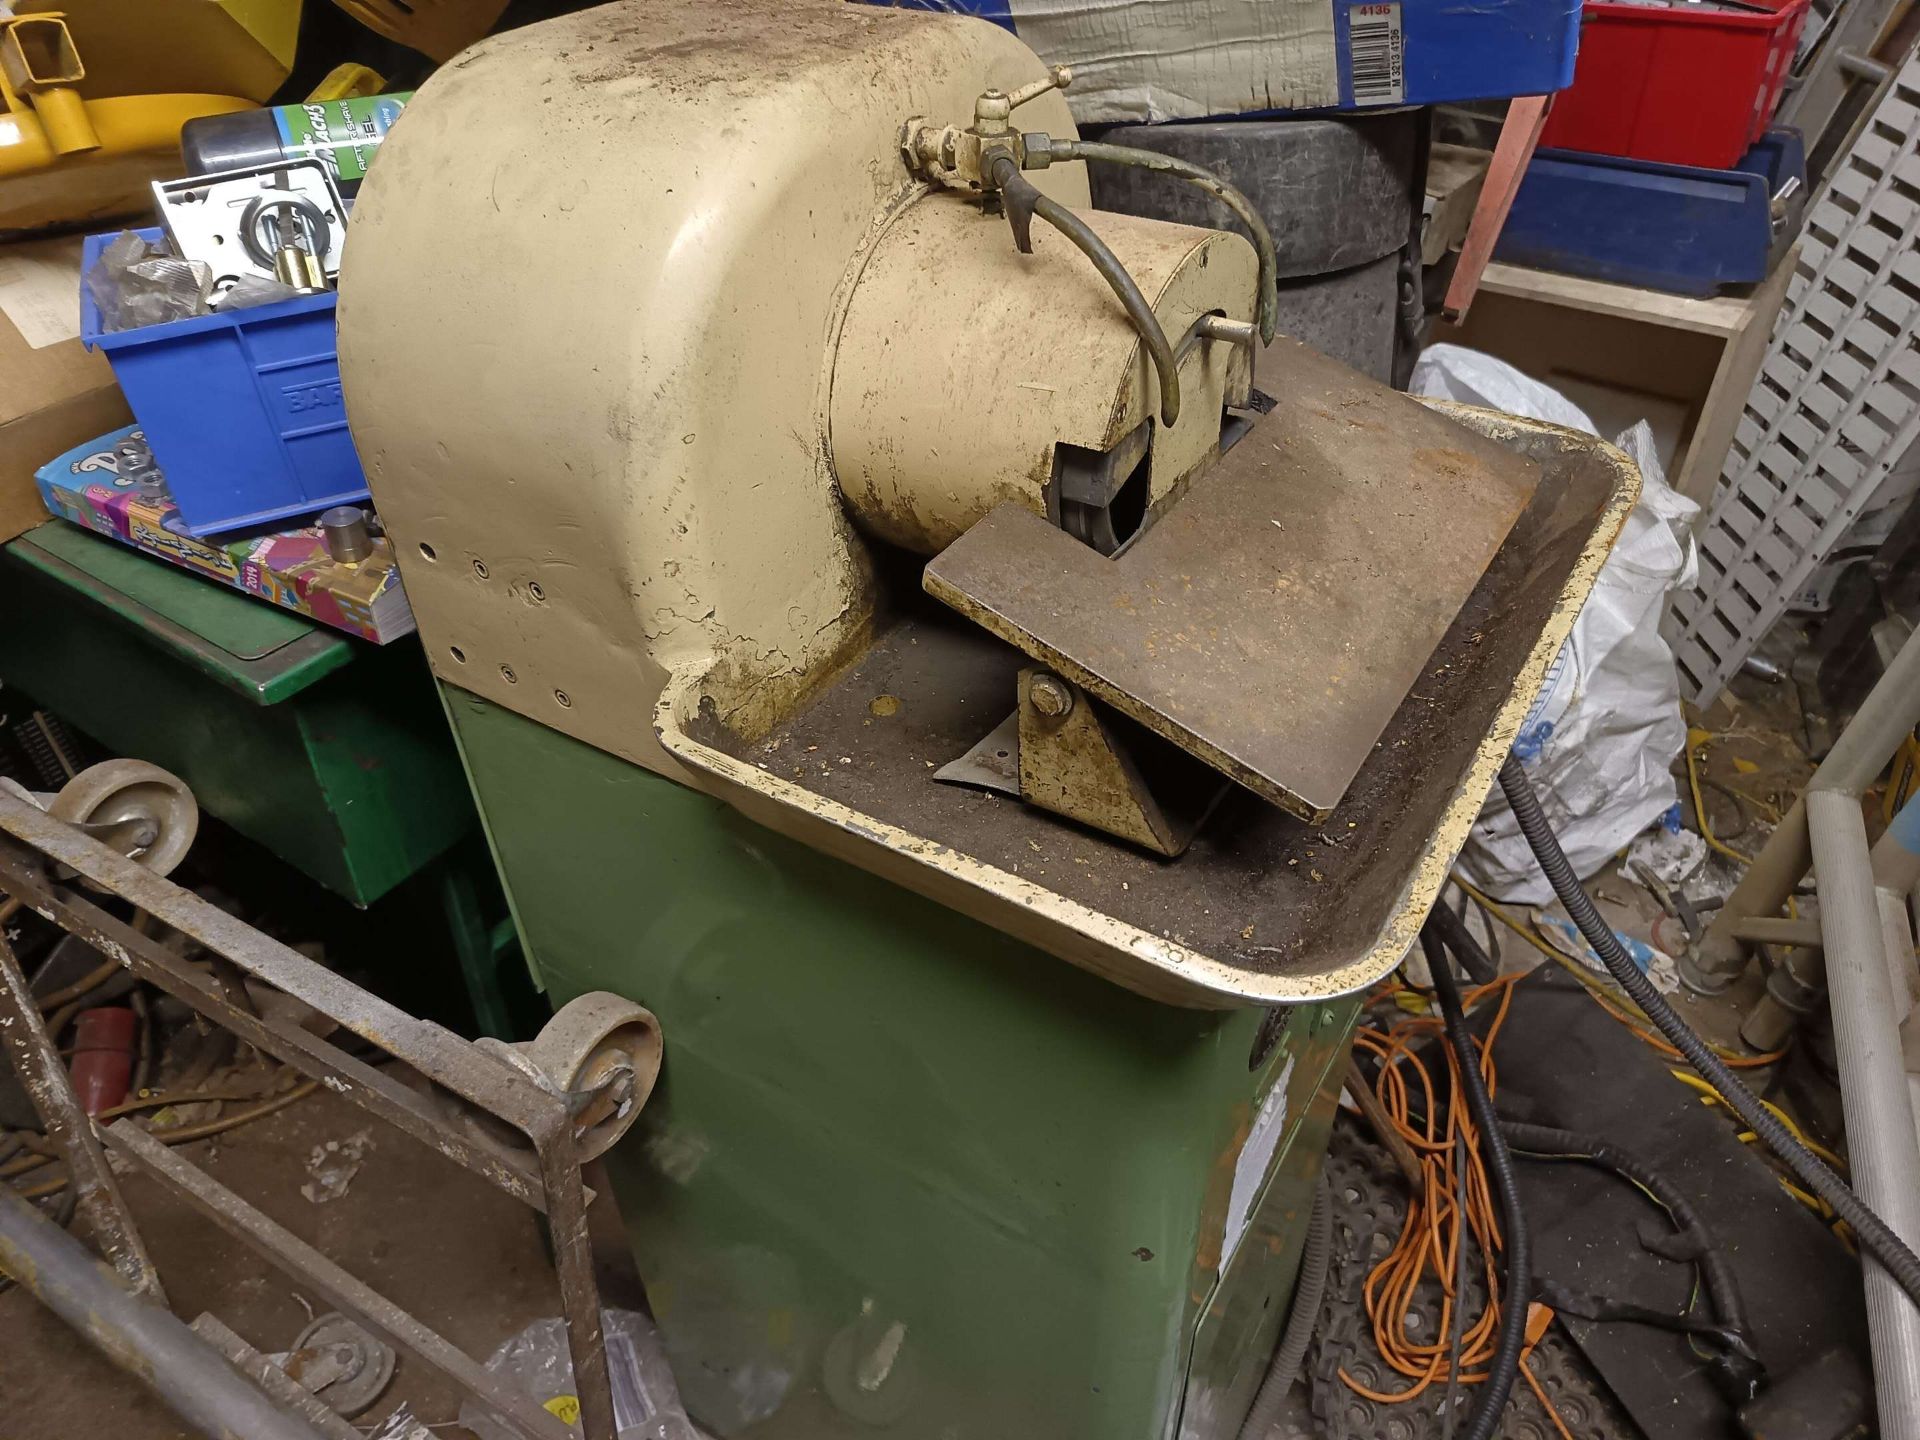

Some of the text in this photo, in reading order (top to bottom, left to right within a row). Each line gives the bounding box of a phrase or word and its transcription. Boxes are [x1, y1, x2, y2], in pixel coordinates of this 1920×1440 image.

[1360, 5, 1391, 16] 4136
[1390, 29, 1401, 88] M 3213 4136
[340, 100, 368, 171] AFTR SHAVE
[246, 565, 259, 589] 2014
